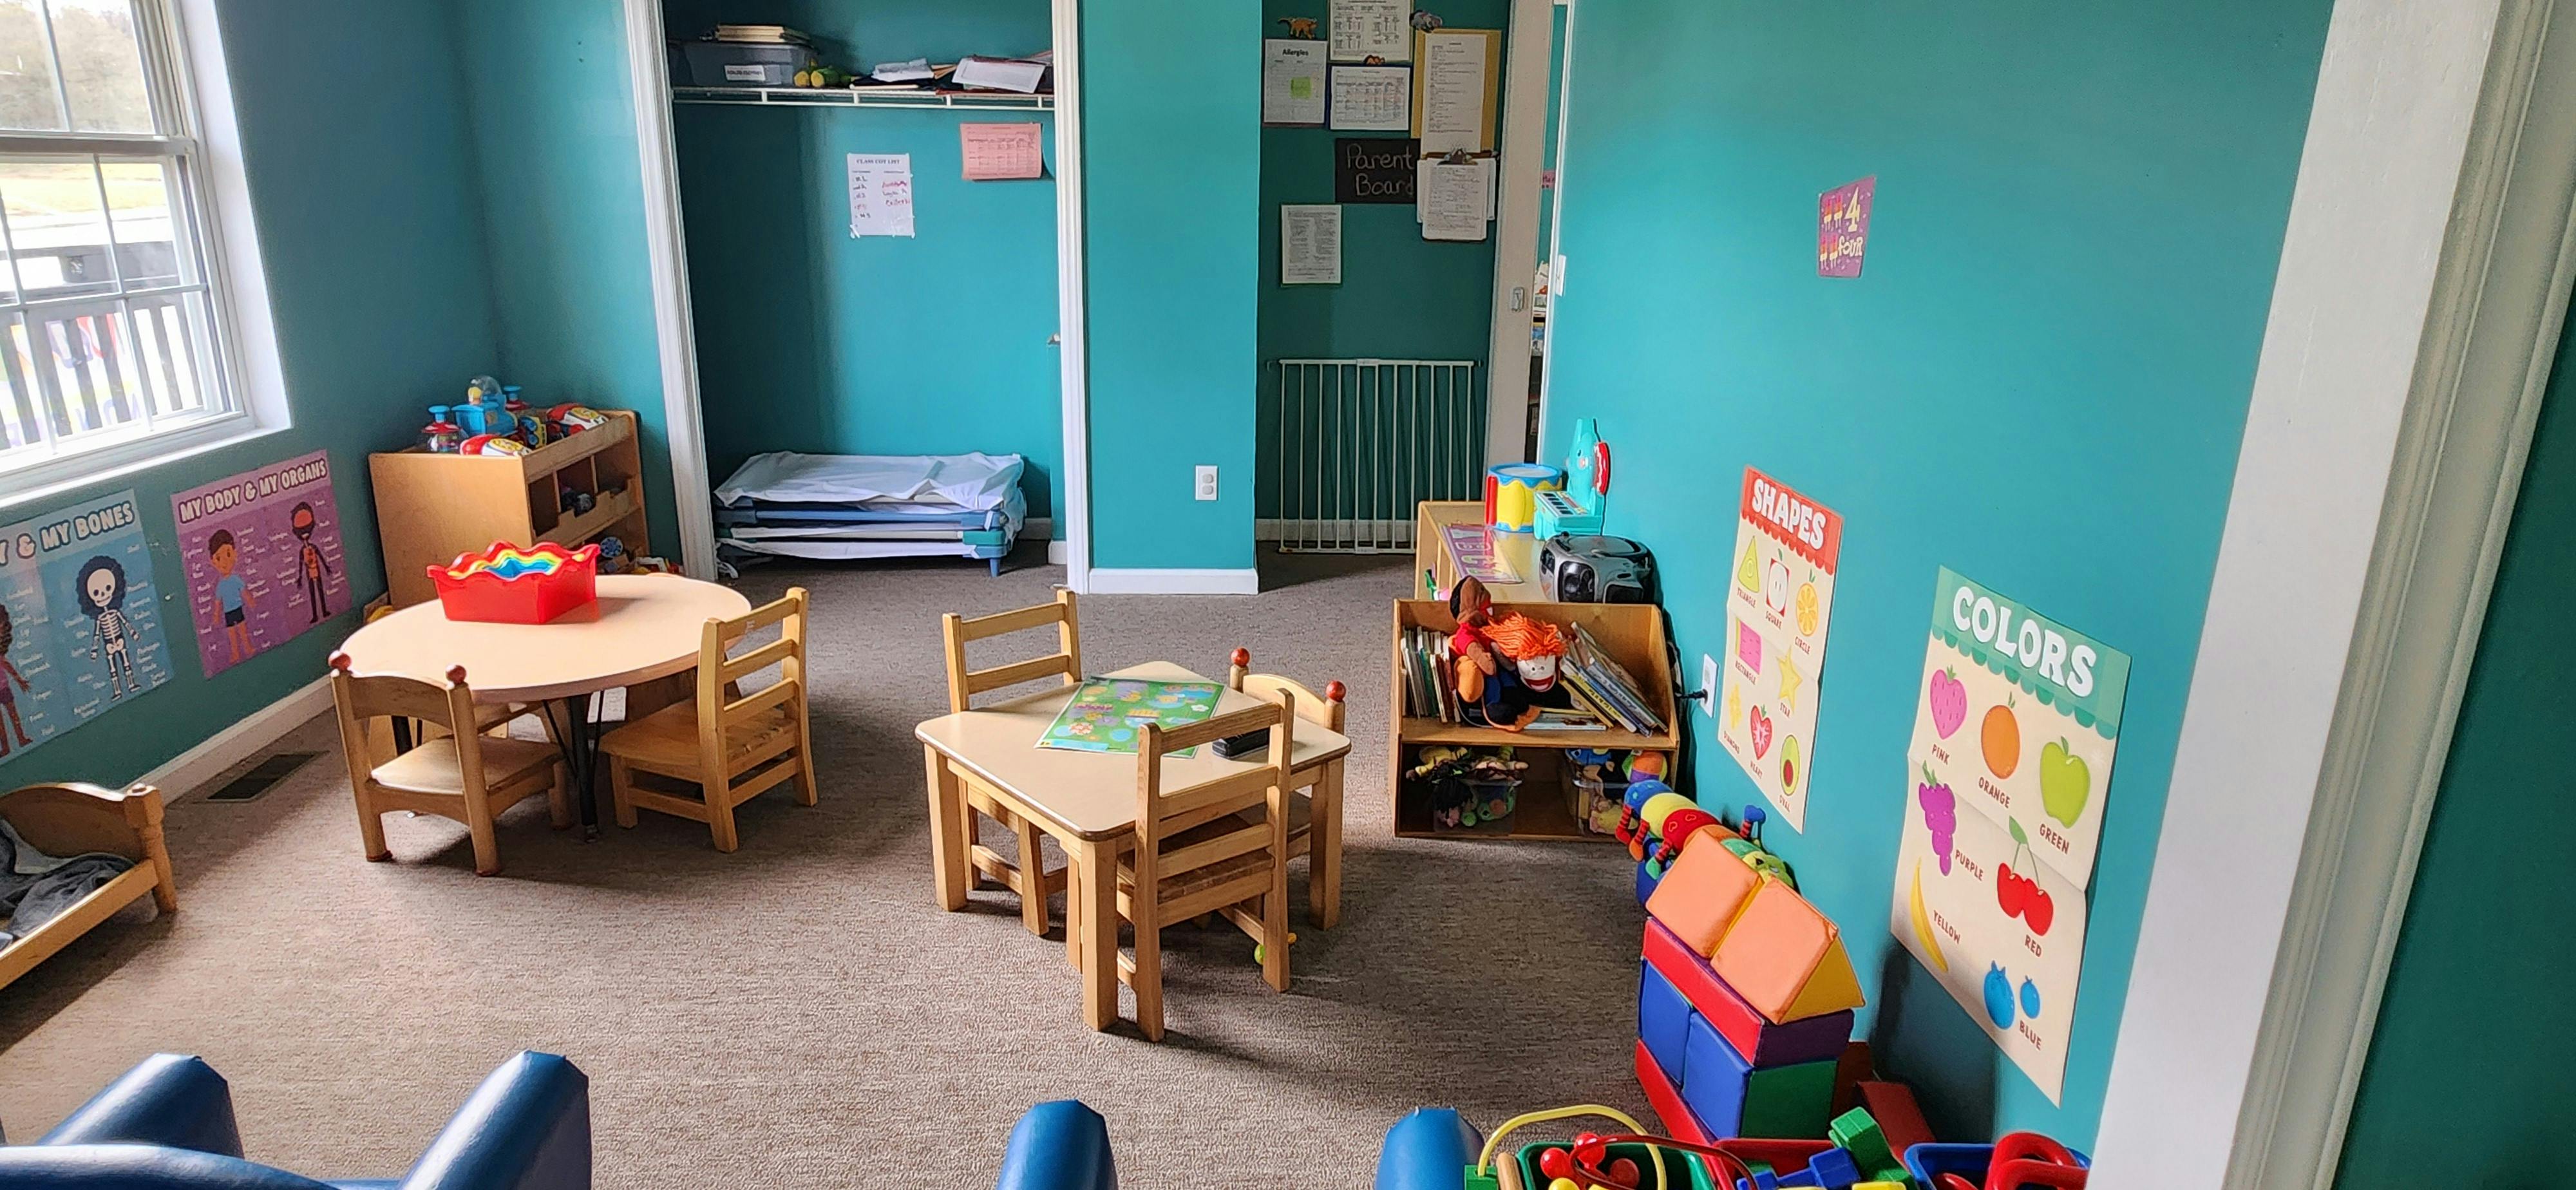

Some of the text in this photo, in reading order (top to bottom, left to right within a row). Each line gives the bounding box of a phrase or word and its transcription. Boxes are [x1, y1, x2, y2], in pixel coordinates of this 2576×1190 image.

[1347, 143, 1415, 170] Parent
[1356, 173, 1414, 196] Board
[1844, 186, 1861, 232] 4
[179, 458, 327, 524] MY BODY & MY ORGANS
[1752, 478, 1826, 550] SHAPES
[17, 533, 36, 559] &
[39, 519, 71, 552] MY
[73, 500, 135, 540] BONES
[1737, 587, 1757, 609] TRIANGLE
[1765, 610, 1782, 630] SQUARE
[1795, 636, 1810, 655] CIRCLE
[1953, 586, 2097, 697] COLORS
[1735, 660, 1757, 686] RECTANGLE
[1780, 702, 1790, 719] STAR
[1931, 743, 1950, 765] PINK
[1750, 760, 1763, 779] HEART
[1779, 794, 1790, 813] OVAL
[1978, 777, 2011, 809] ORANGE
[2040, 823, 2070, 855] GREEN
[1955, 849, 1984, 882] PURPLE
[1933, 909, 1961, 945] YELLOW
[2024, 934, 2042, 958] RED
[2019, 1019, 2042, 1051] BLUE
